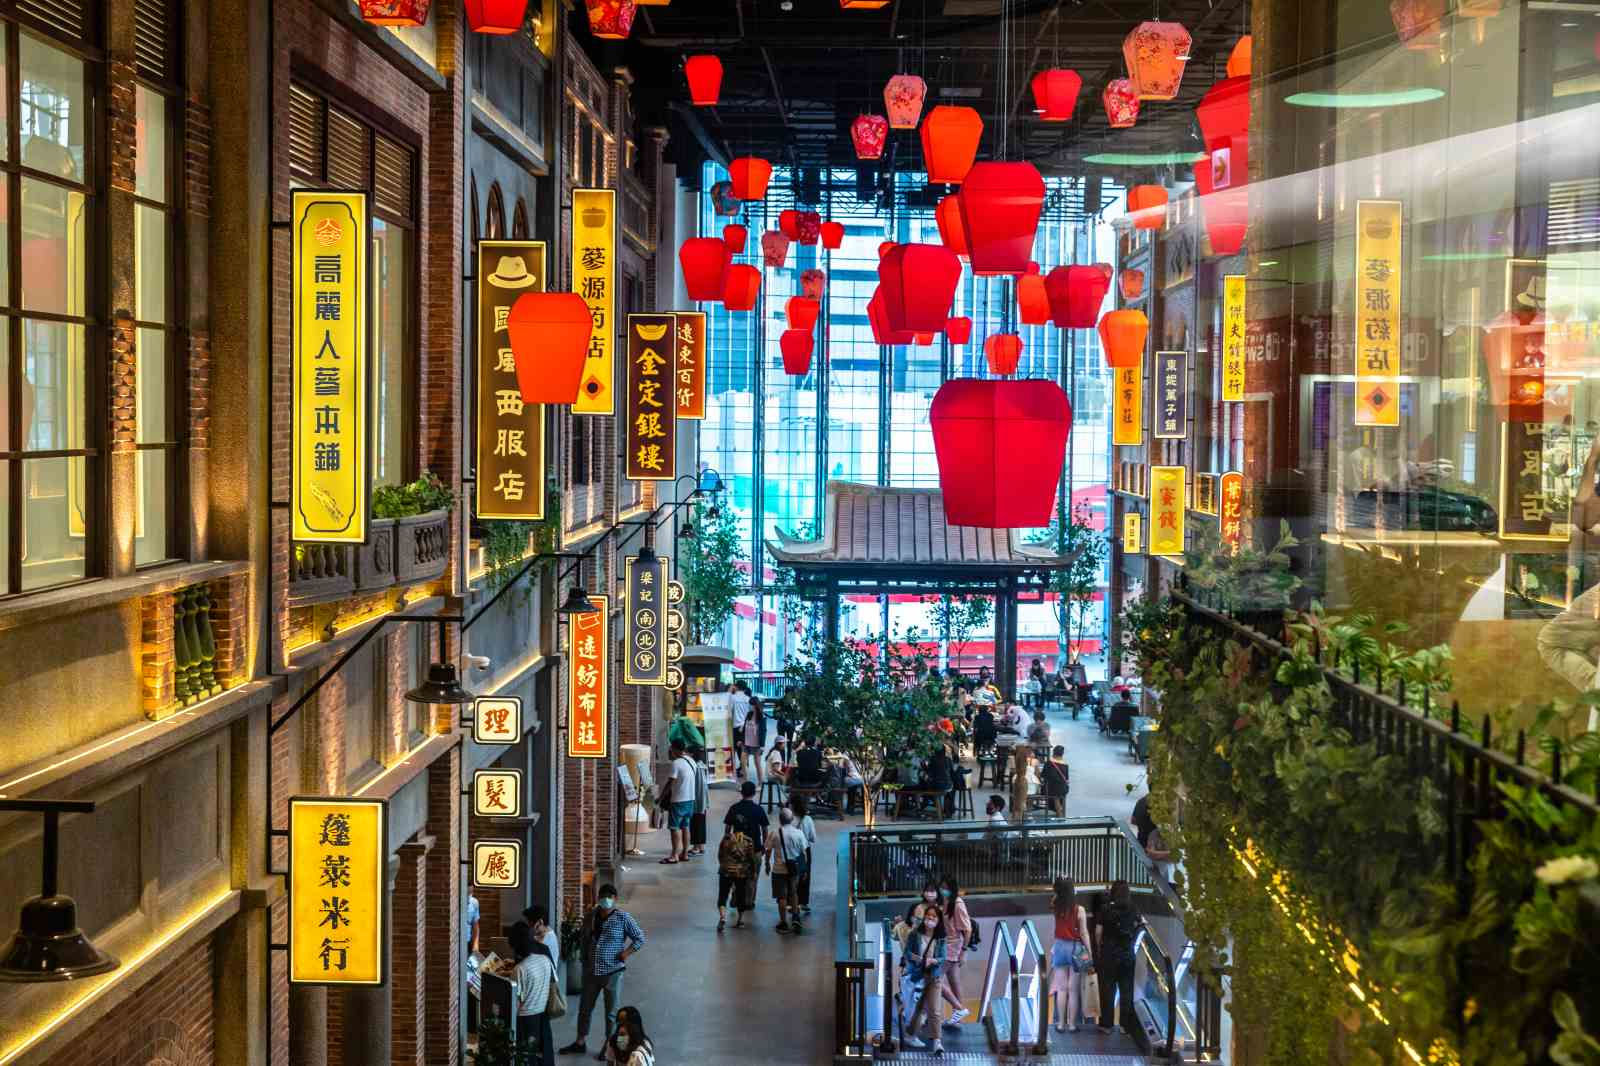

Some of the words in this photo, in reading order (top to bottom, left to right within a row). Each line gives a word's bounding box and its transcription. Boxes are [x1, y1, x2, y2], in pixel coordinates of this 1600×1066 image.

[636, 348, 667, 471] 金定銀樓
[677, 323, 695, 407] 遠東百貨
[577, 636, 599, 745] 遠紡布莊
